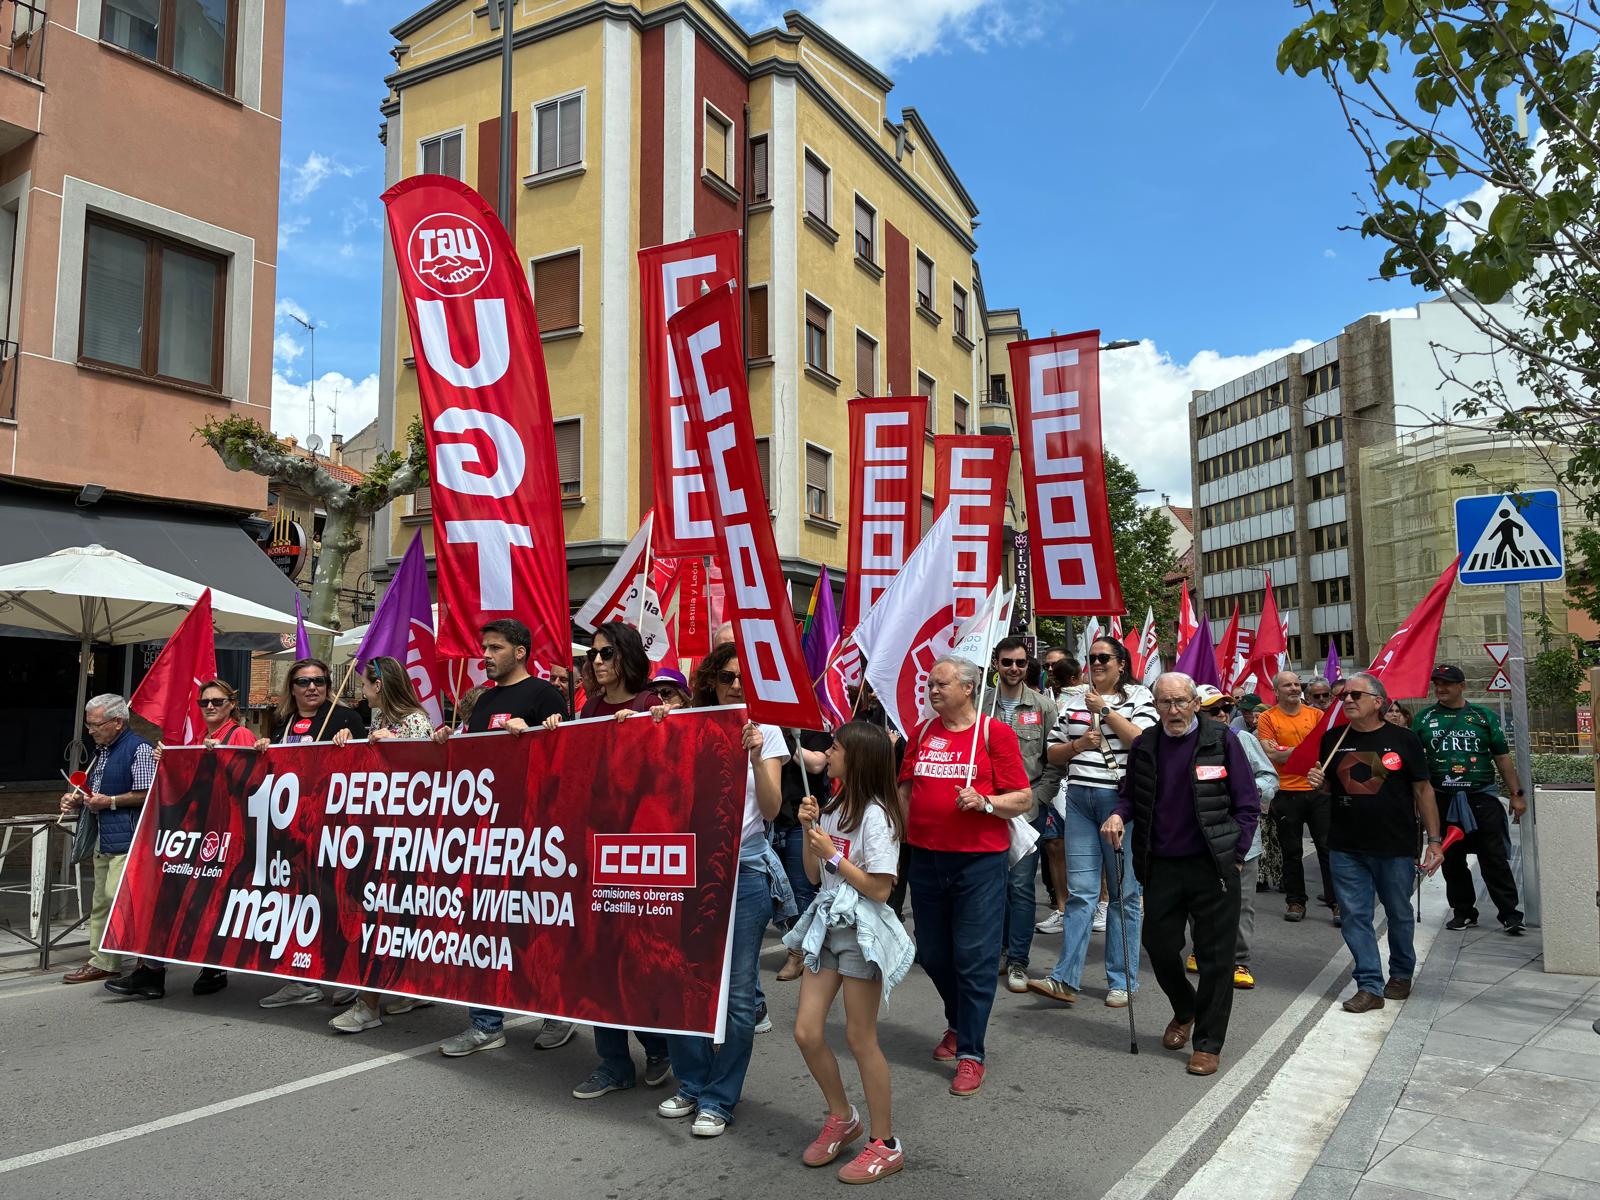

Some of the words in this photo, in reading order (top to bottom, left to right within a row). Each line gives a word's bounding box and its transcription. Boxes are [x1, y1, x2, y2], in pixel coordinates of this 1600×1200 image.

[1028, 348, 1102, 600] CCOO
[687, 320, 798, 703] CCOO
[690, 561, 698, 589] León
[690, 589, 698, 598] y
[688, 597, 697, 636] Castilla
[928, 750, 955, 762] POSIBLE
[956, 751, 963, 761] Y
[326, 769, 499, 823] DERECHOS,
[154, 830, 202, 860] UGT
[317, 825, 364, 870] NO
[373, 826, 578, 879] TRINCHERAS.
[600, 844, 687, 876] CCOO
[162, 861, 192, 876] Castilla
[193, 867, 201, 880] y
[199, 863, 222, 877] León
[269, 850, 291, 887] de
[362, 881, 466, 926] SALARIOS,
[471, 888, 576, 928] VIVIENDA
[591, 901, 602, 913] de
[604, 901, 636, 915] Castilla
[637, 906, 644, 916] y
[646, 902, 673, 916] León
[592, 888, 641, 901] comisiones
[643, 889, 684, 902] obreras
[217, 887, 321, 960] mayo
[291, 952, 312, 969] 2026
[360, 923, 378, 954] Y
[375, 925, 513, 972] DEMOCRACIA
